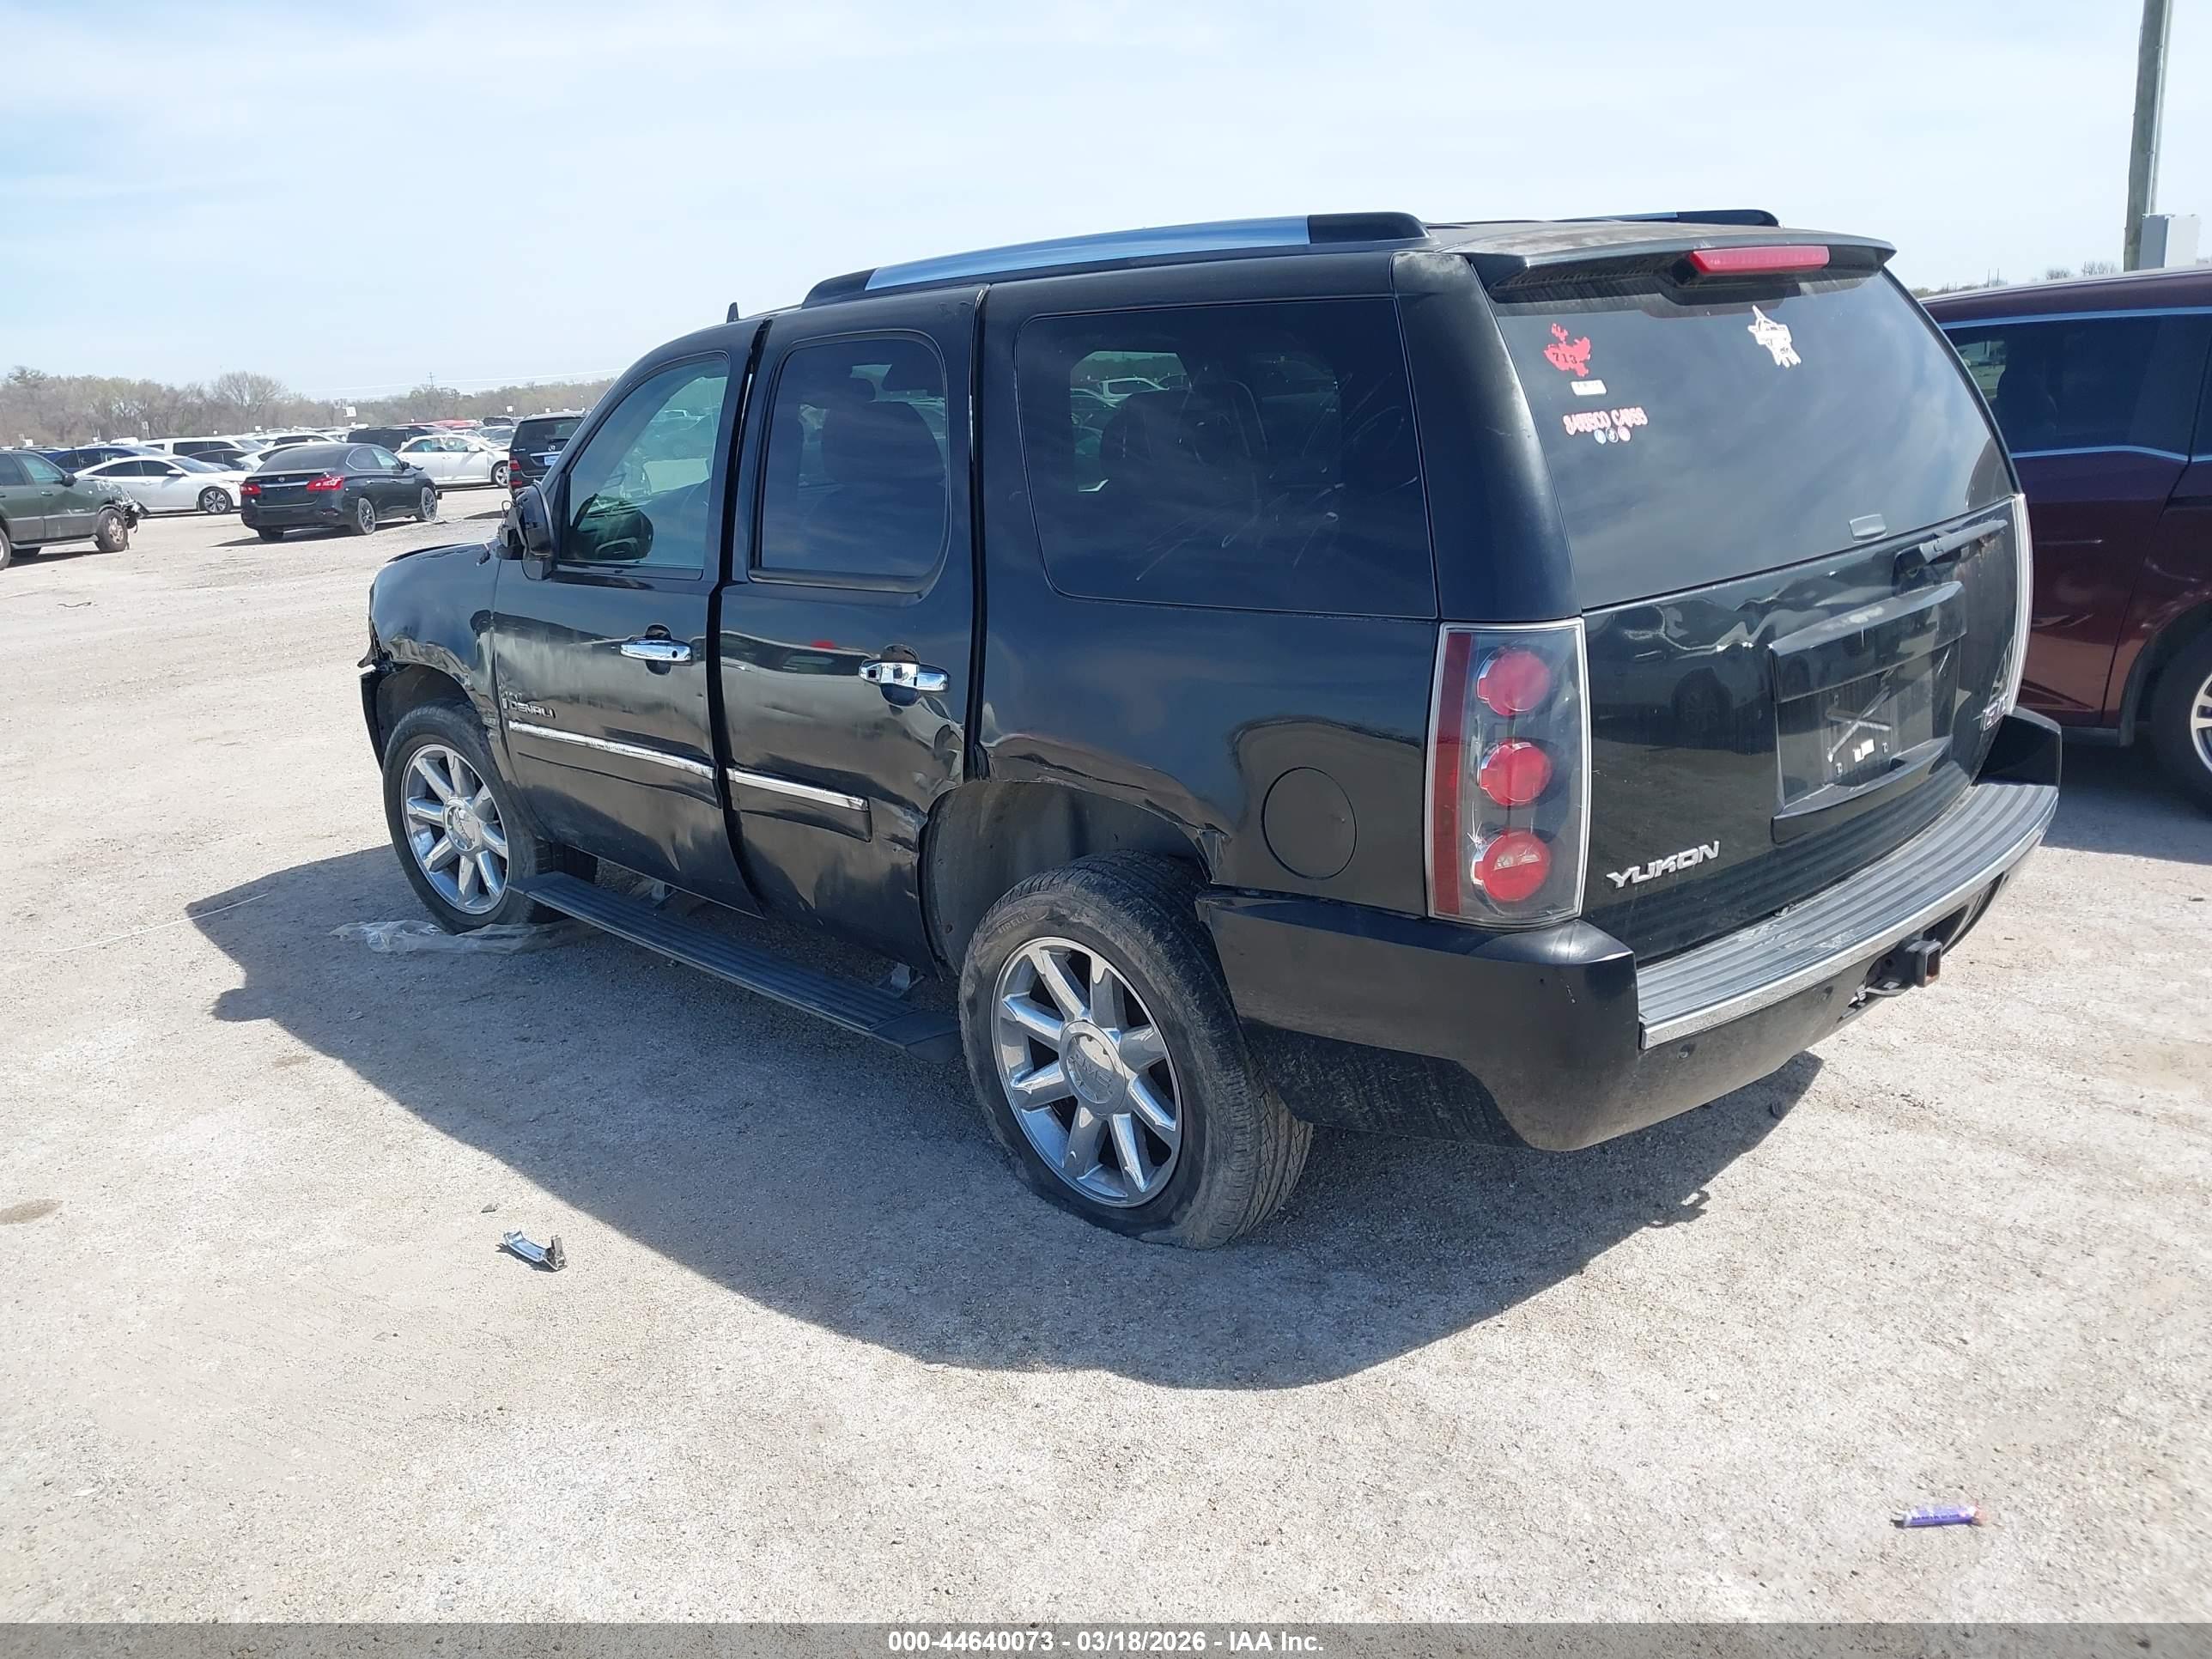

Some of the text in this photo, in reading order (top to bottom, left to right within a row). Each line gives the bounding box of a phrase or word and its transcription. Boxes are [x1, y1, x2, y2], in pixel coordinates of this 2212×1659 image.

[1552, 352, 1577, 364] 713
[509, 700, 556, 719] DENALI
[1606, 840, 1721, 889] YUKON
